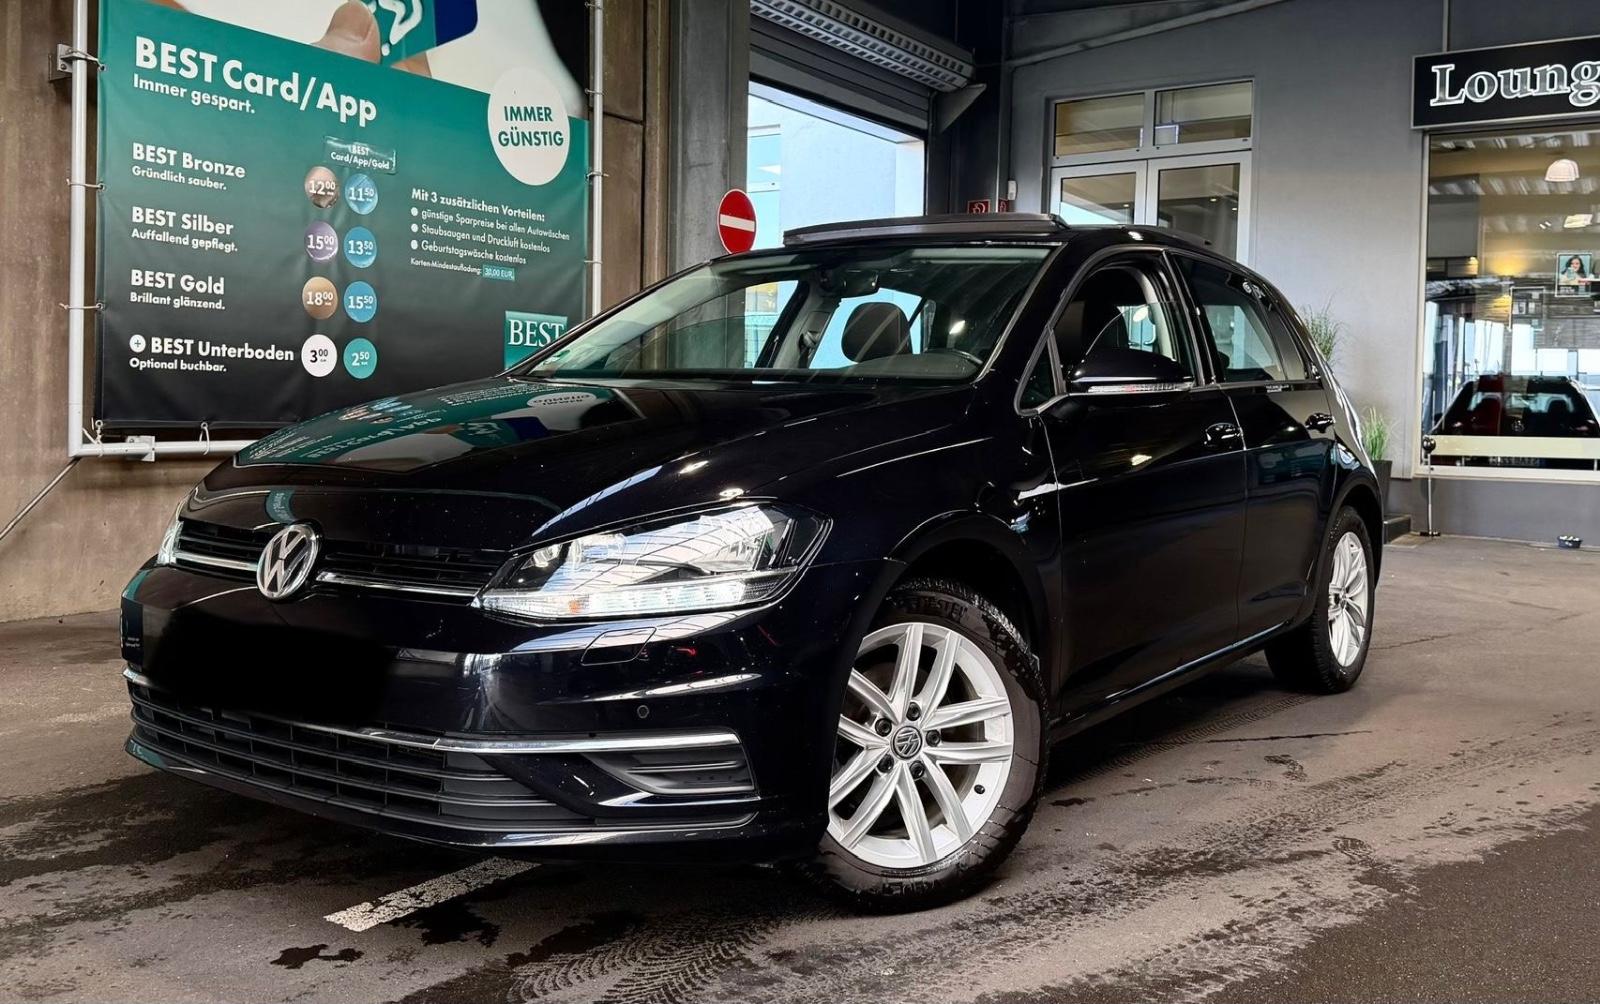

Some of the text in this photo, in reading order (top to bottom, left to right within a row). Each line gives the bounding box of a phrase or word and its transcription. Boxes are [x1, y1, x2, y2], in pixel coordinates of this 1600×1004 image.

[133, 73, 256, 114] Immer gespart.
[135, 35, 377, 127] BEST Card/App
[1429, 61, 1600, 107] Loung
[503, 105, 553, 122] IMMER
[498, 126, 564, 147] GÜNSTIG
[132, 142, 246, 179] BEST Bronze
[351, 144, 370, 156] BEST
[131, 165, 227, 190] Gründlich sauber.
[411, 188, 545, 222] Mit 3 zusätzlichen Vorteilen:
[131, 206, 234, 235] BEST Silber
[421, 209, 454, 223] günstige
[455, 214, 495, 229] Sparpreise
[496, 220, 508, 230] bei
[508, 223, 526, 234] allen
[131, 228, 238, 252] Auffallend gepflegt.
[421, 224, 550, 253] Staubsaugen und Druckluft kostenlos
[421, 239, 526, 264] Geburtstagswäsche kostenlos
[131, 269, 225, 295] BEST Gold
[130, 291, 226, 310] Brillant glänzend.
[507, 319, 565, 348] BEST
[151, 337, 294, 361] BEST Unterboden
[129, 358, 227, 372] Optional buchbar.
